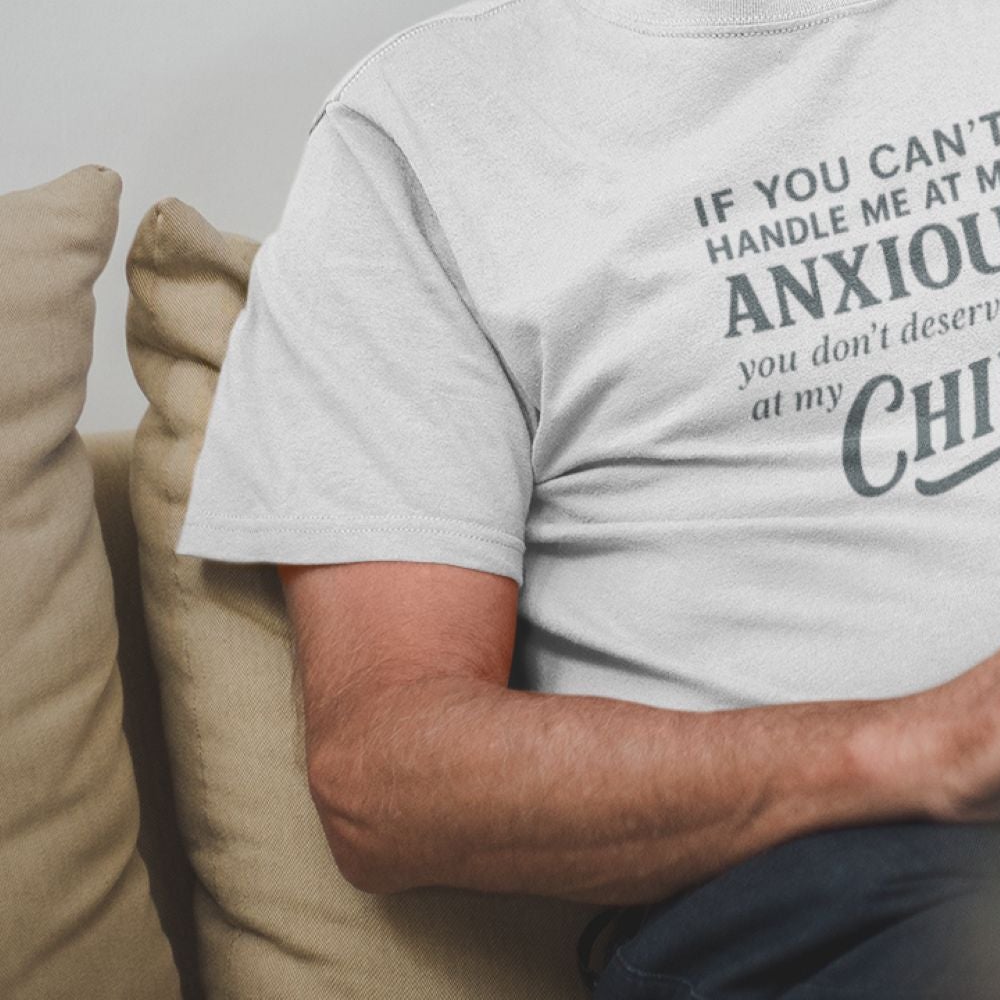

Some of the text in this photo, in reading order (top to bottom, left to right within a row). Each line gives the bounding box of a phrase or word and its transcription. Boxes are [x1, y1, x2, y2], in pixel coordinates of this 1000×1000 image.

[694, 187, 735, 228] IF
[753, 156, 850, 210] YOU
[705, 205, 849, 265] HANDLE
[861, 188, 911, 227] ME
[925, 172, 962, 210] AT
[738, 349, 798, 390] you
[751, 390, 783, 421] at
[794, 381, 844, 412] my
